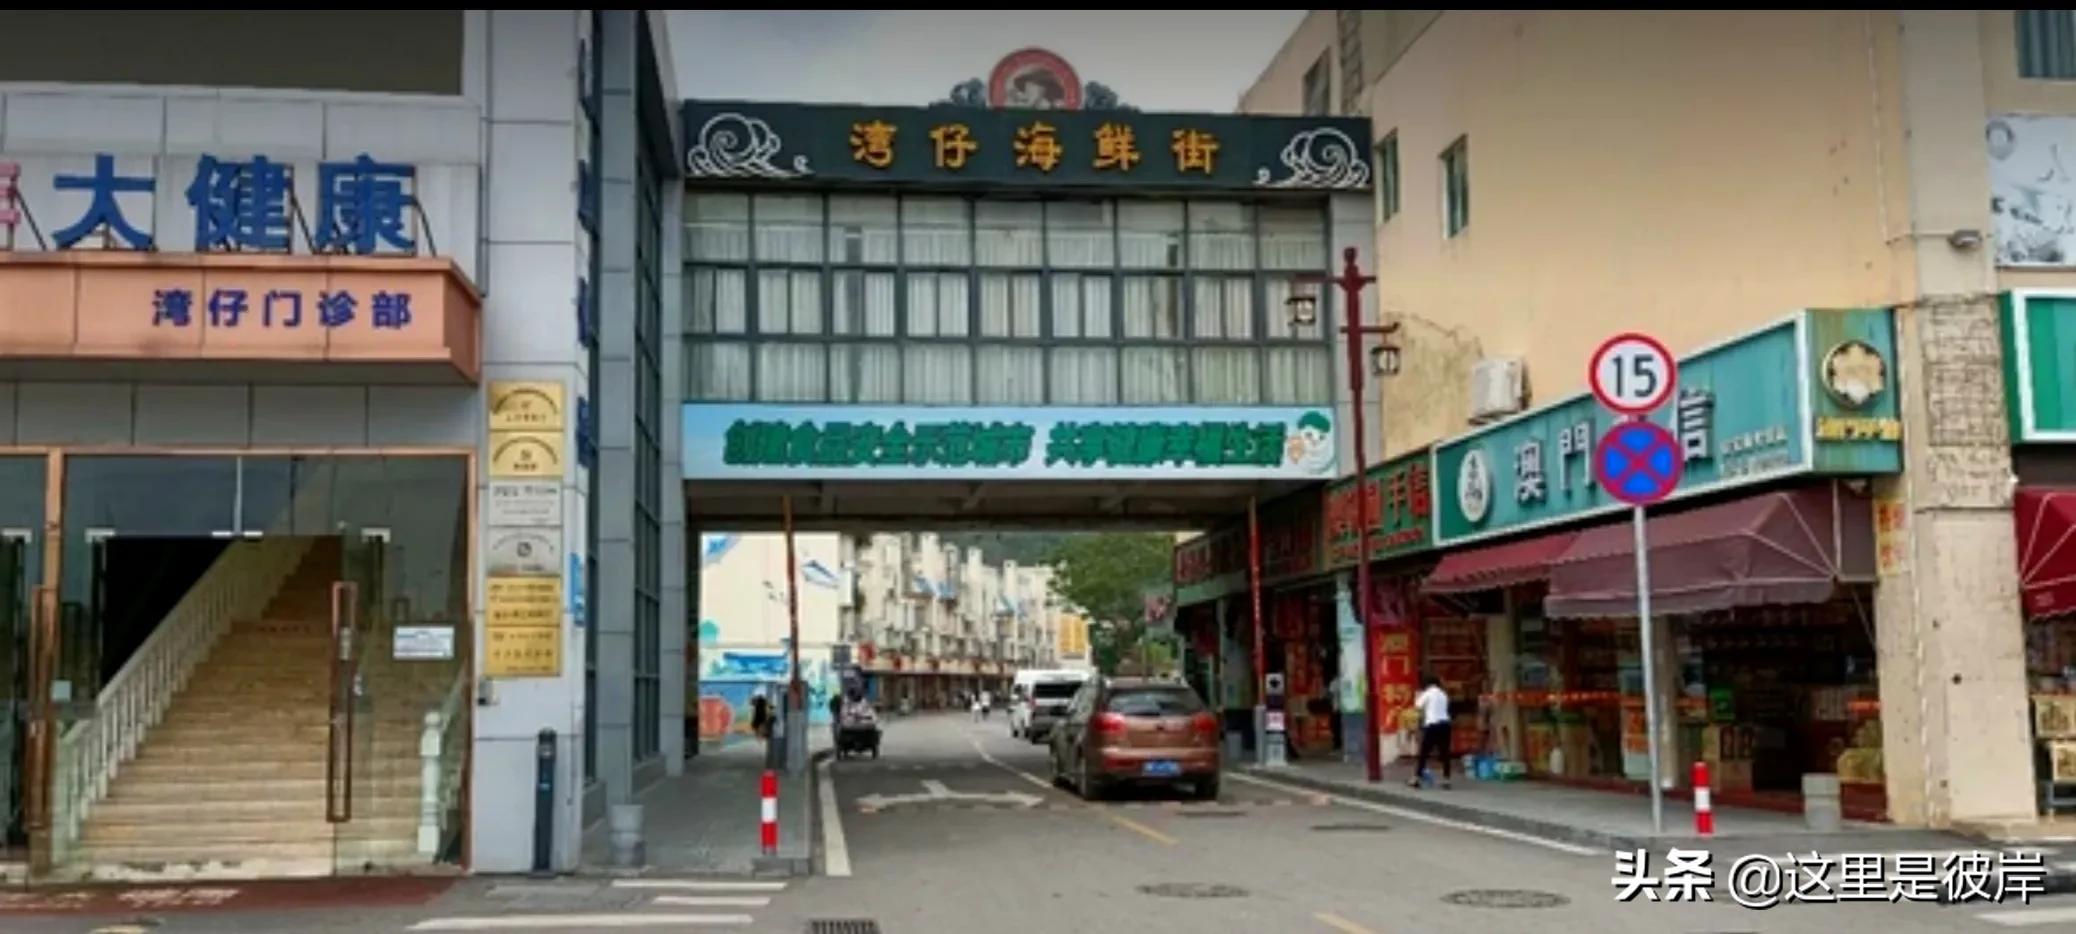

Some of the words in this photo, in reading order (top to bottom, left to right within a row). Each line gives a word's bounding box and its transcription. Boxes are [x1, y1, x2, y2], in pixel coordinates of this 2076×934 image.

[849, 119, 1221, 173] 湾仔海鲜街
[52, 153, 417, 254] 大健康
[152, 289, 413, 329] 湾仔门诊部
[1611, 354, 1658, 398] 15
[1513, 385, 1715, 503] 澳門信
